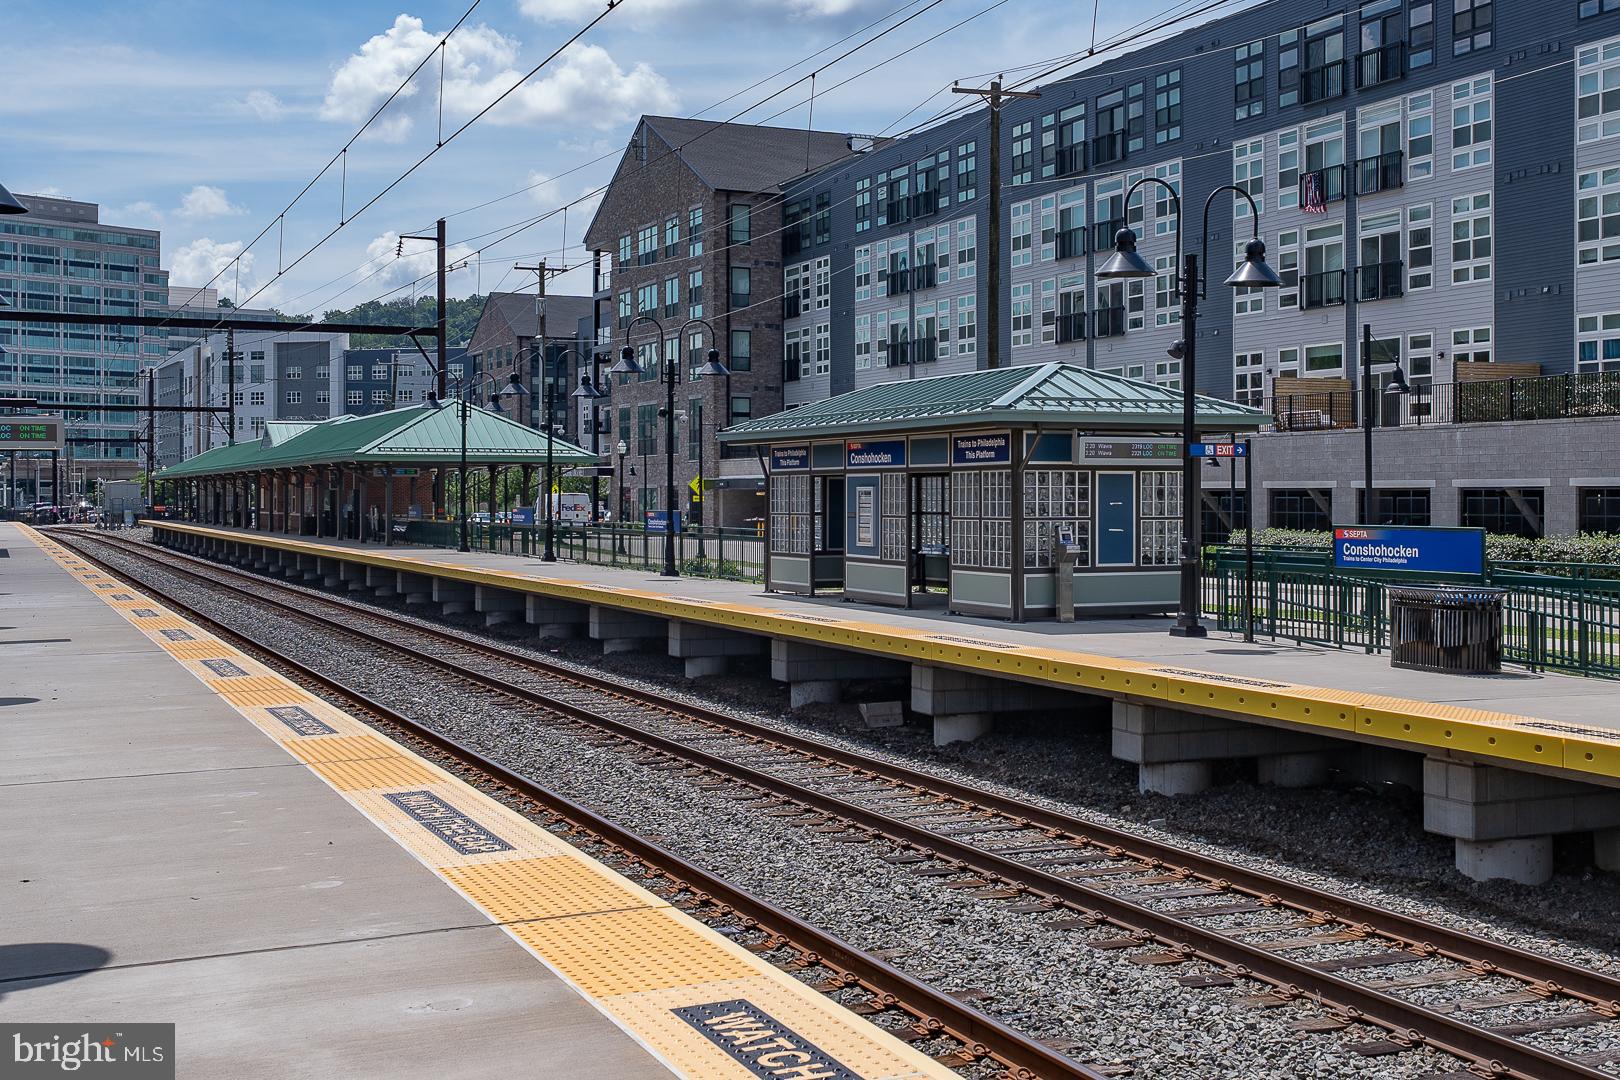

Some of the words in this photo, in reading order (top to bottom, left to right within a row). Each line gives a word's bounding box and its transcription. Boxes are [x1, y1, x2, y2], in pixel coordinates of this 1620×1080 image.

[957, 440, 971, 448] Trains
[977, 437, 1005, 448] Philadelphia
[787, 449, 806, 458] Philadelphia
[965, 450, 976, 459] This
[976, 450, 996, 459] Platform
[1216, 445, 1234, 455] EXIT
[850, 452, 892, 464] Conshohocken
[561, 503, 586, 512] FedEx
[1349, 530, 1367, 538] SEPTA
[1343, 542, 1419, 558] Conshohocken
[1374, 556, 1382, 564] City
[1382, 557, 1408, 565] Philadelphia
[703, 1011, 837, 1080] WATCH
